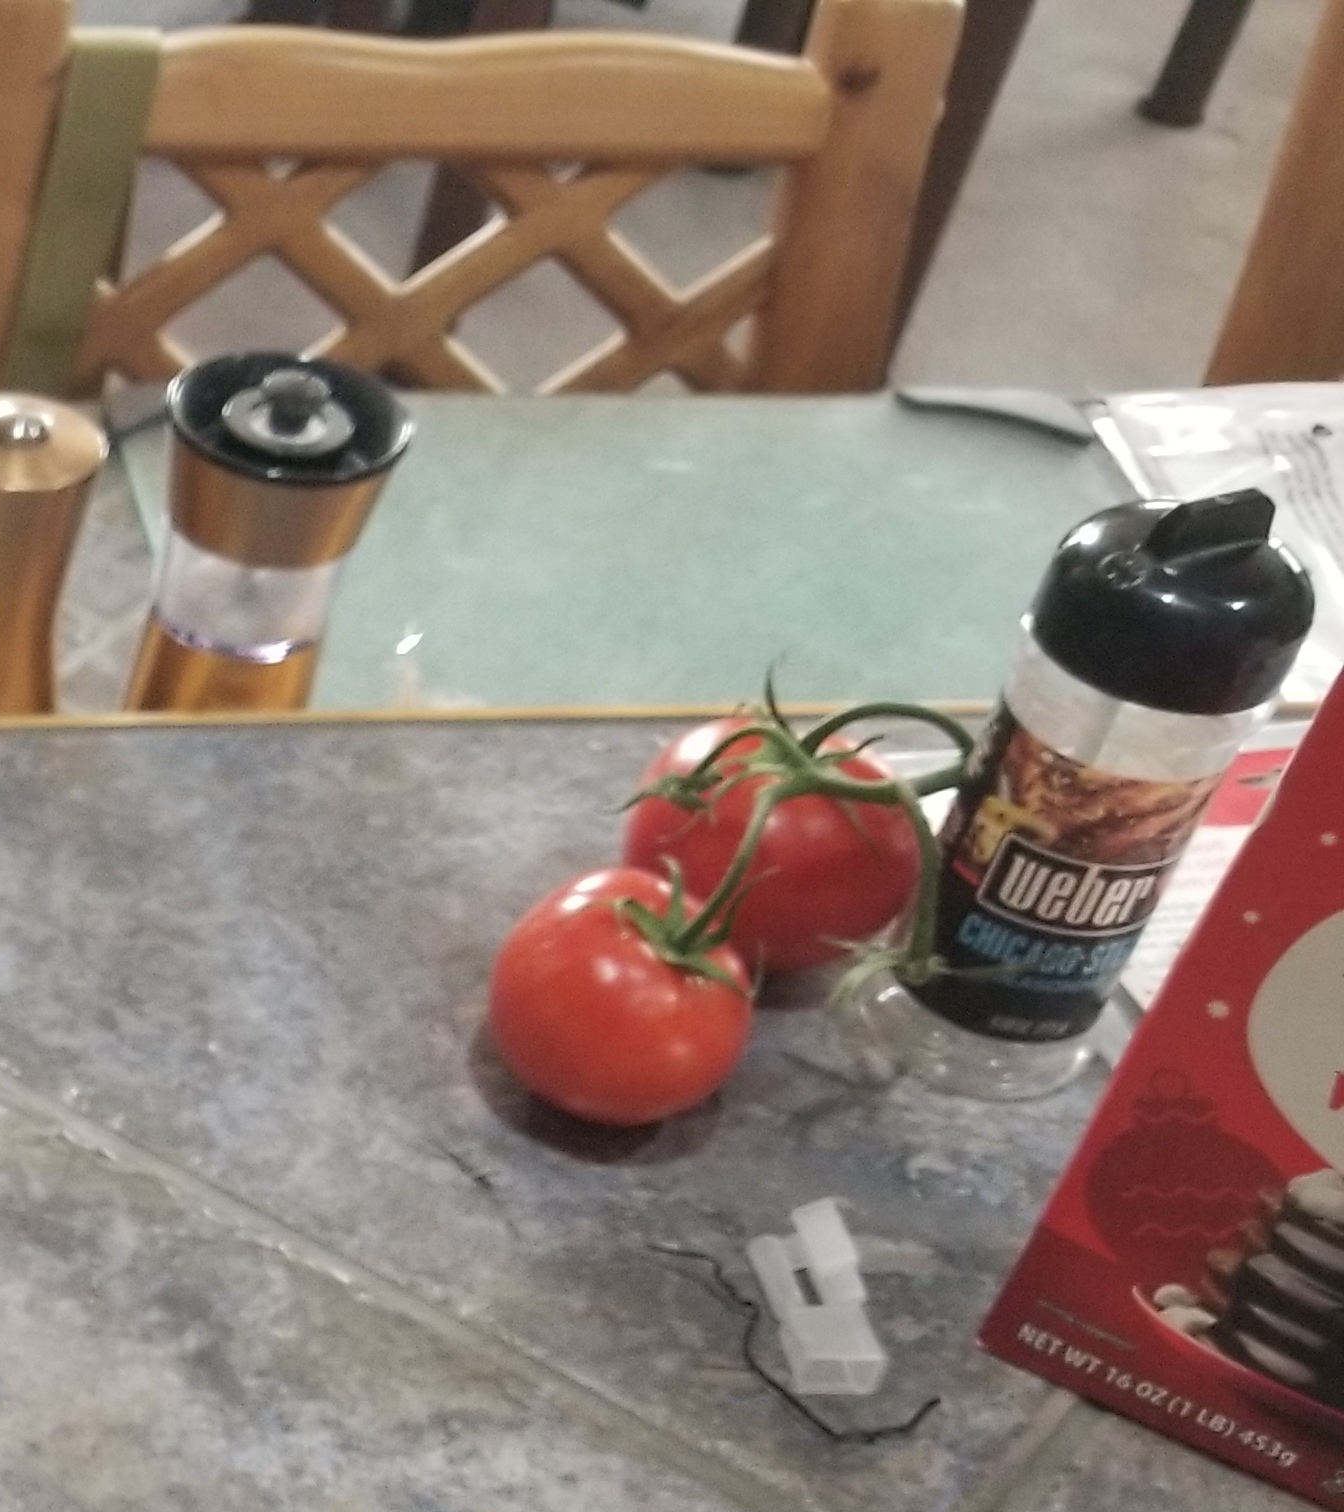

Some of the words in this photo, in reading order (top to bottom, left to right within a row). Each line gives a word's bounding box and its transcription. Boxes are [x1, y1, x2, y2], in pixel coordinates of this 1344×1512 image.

[1018, 1322, 1062, 1356] NET
[1063, 1345, 1102, 1375] WT
[1106, 1366, 1131, 1390] 16
[1135, 1380, 1168, 1406] OZ
[1238, 1429, 1299, 1467] 453g
